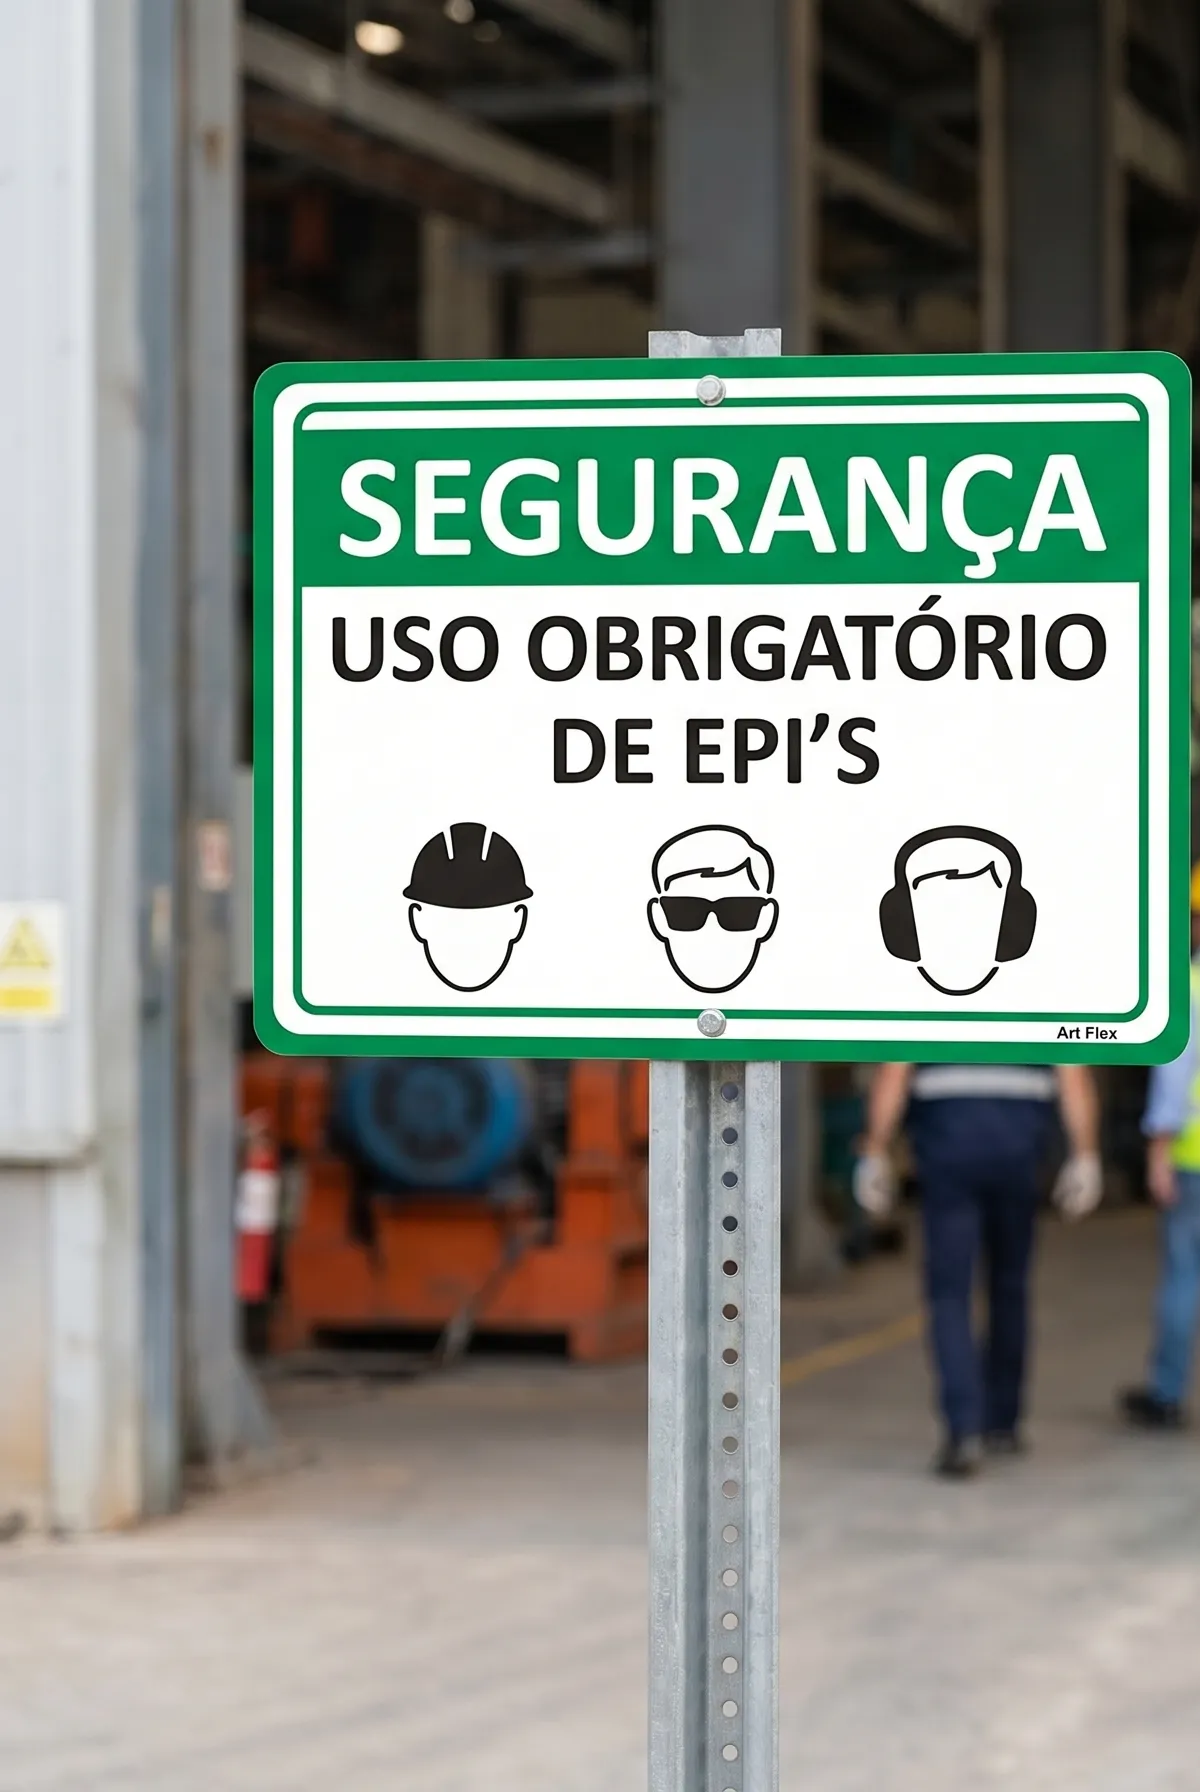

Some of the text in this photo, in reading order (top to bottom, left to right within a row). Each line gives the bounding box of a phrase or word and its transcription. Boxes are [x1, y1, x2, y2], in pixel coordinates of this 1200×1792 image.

[338, 453, 1107, 579] SEGURANÇA
[332, 594, 1107, 683] USO OBRIGATÓRIO
[553, 718, 654, 784] DE
[1056, 1026, 1118, 1040] Art Flex
